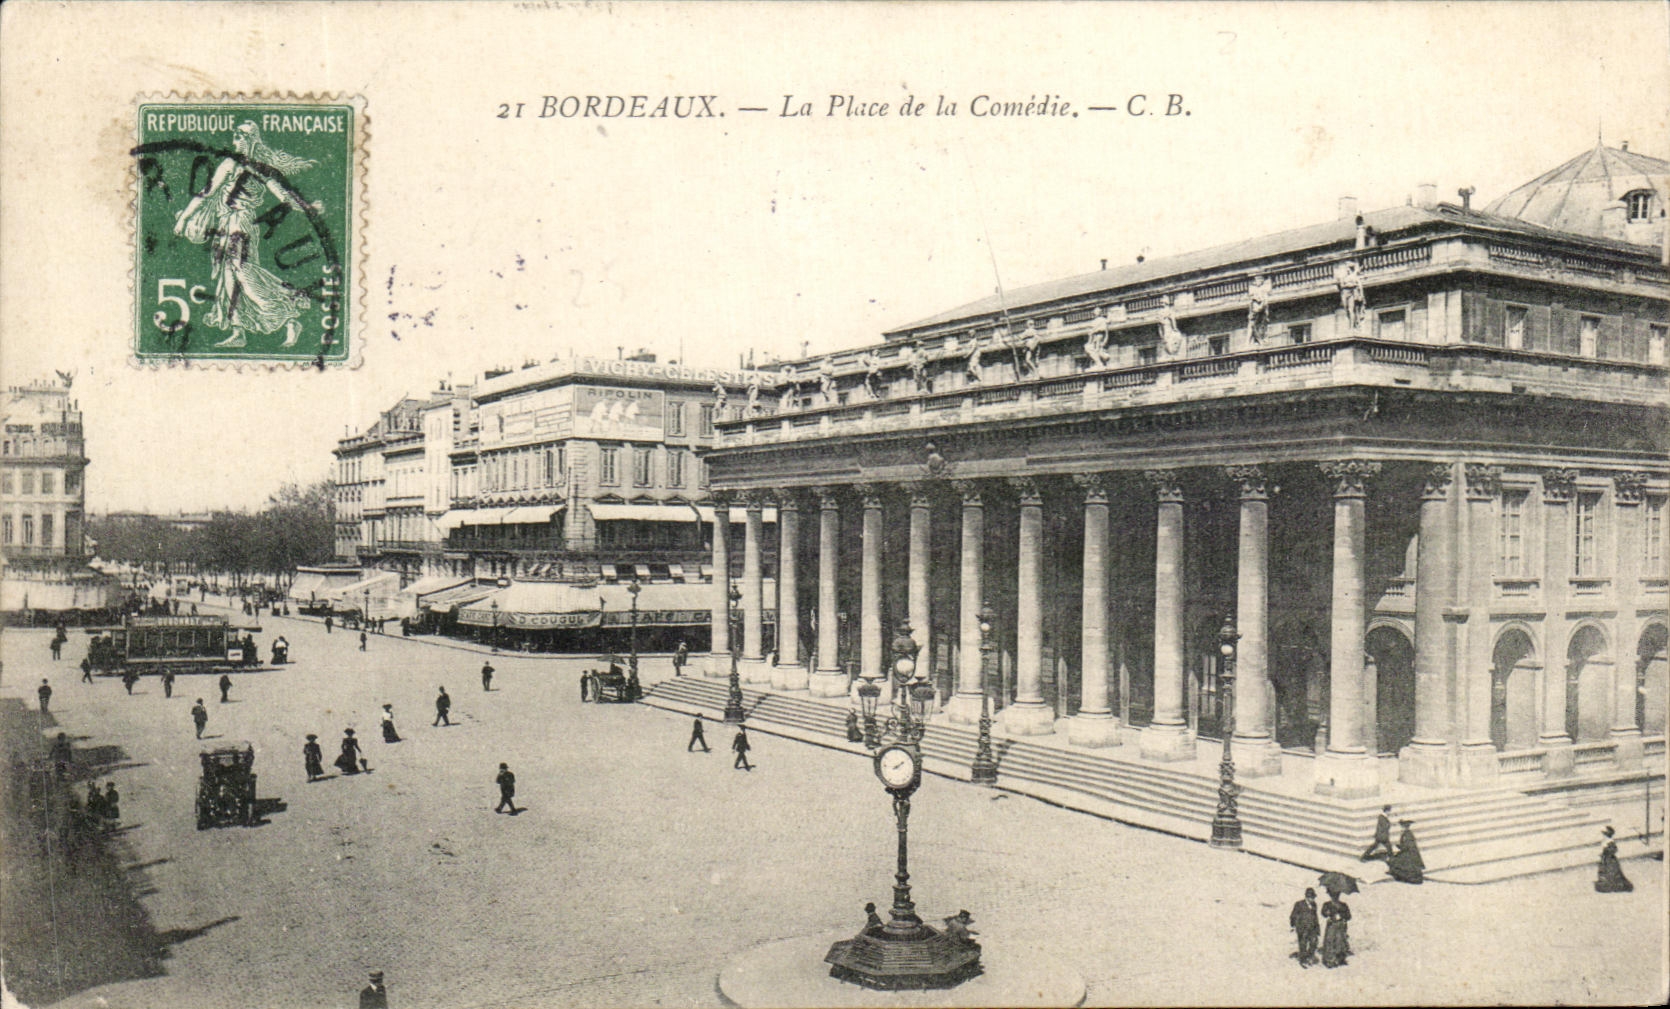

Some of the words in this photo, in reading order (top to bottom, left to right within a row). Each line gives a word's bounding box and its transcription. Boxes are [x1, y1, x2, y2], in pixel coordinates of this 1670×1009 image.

[147, 113, 235, 134] REPUBLIQUE
[262, 113, 344, 134] FRANÇAISE
[321, 264, 342, 346] POSTES
[587, 388, 654, 400] RIPOLIN
